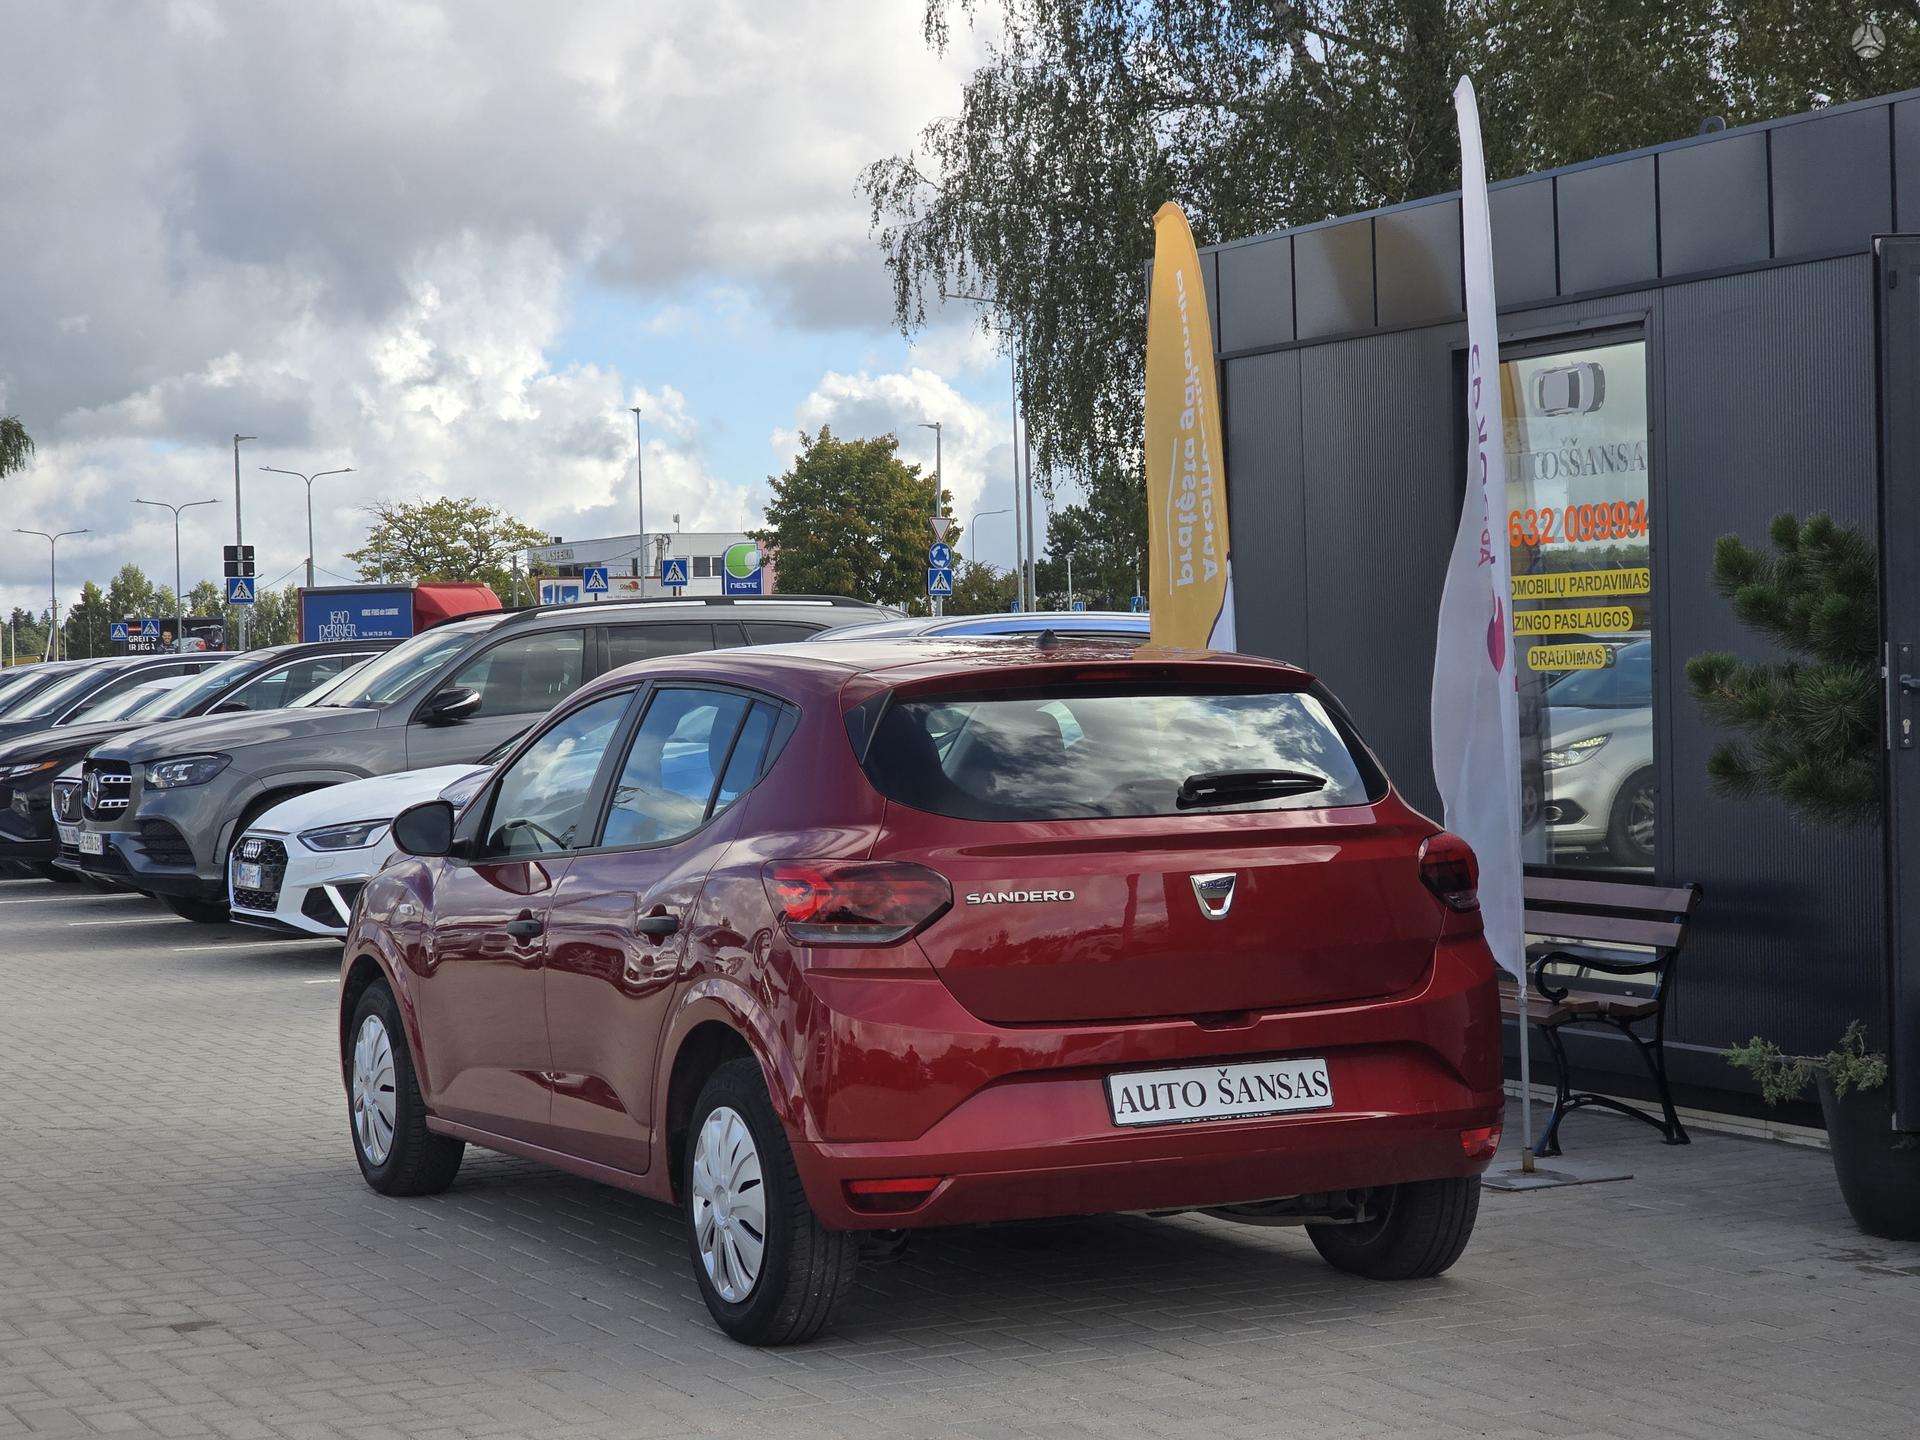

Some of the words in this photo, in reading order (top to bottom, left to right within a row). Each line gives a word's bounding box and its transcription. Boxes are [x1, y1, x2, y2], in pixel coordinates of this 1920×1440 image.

[1564, 498, 1647, 542] 09994
[1511, 579, 1566, 596] OMOBILIŲ
[1569, 572, 1649, 592] PARDAVIMAS
[1513, 614, 1551, 632] ZINGO
[1554, 610, 1630, 630] PASLAUGOS
[1530, 649, 1603, 666] DRAUDIMAS
[966, 890, 1075, 905] SANDERO
[1117, 1080, 1207, 1114] AUTO
[1217, 1068, 1329, 1105] ŠANSAS
